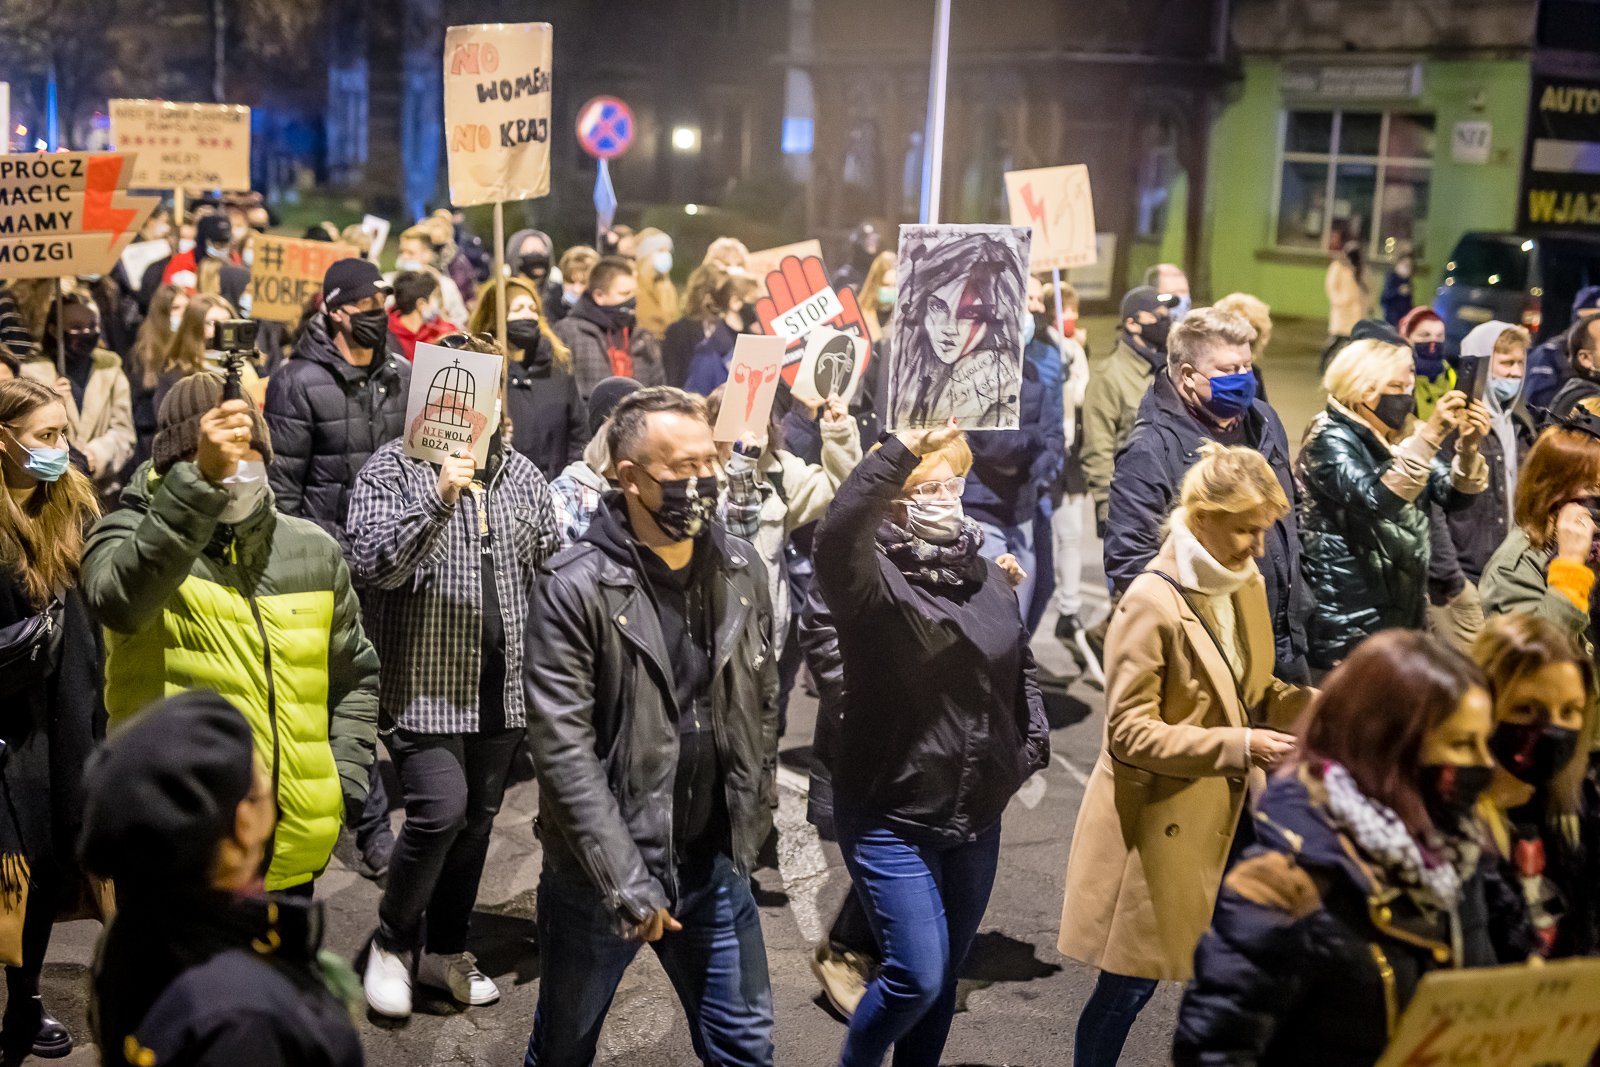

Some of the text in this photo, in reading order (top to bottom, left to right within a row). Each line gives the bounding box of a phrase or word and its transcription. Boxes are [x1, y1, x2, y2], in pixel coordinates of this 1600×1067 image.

[451, 42, 499, 75] NO
[452, 118, 548, 152] NO KRAJ
[1, 154, 83, 179] PRÓCZ
[784, 295, 829, 335] STOP
[421, 437, 449, 452] BOŻA
[423, 425, 473, 444] NIEWOLA
